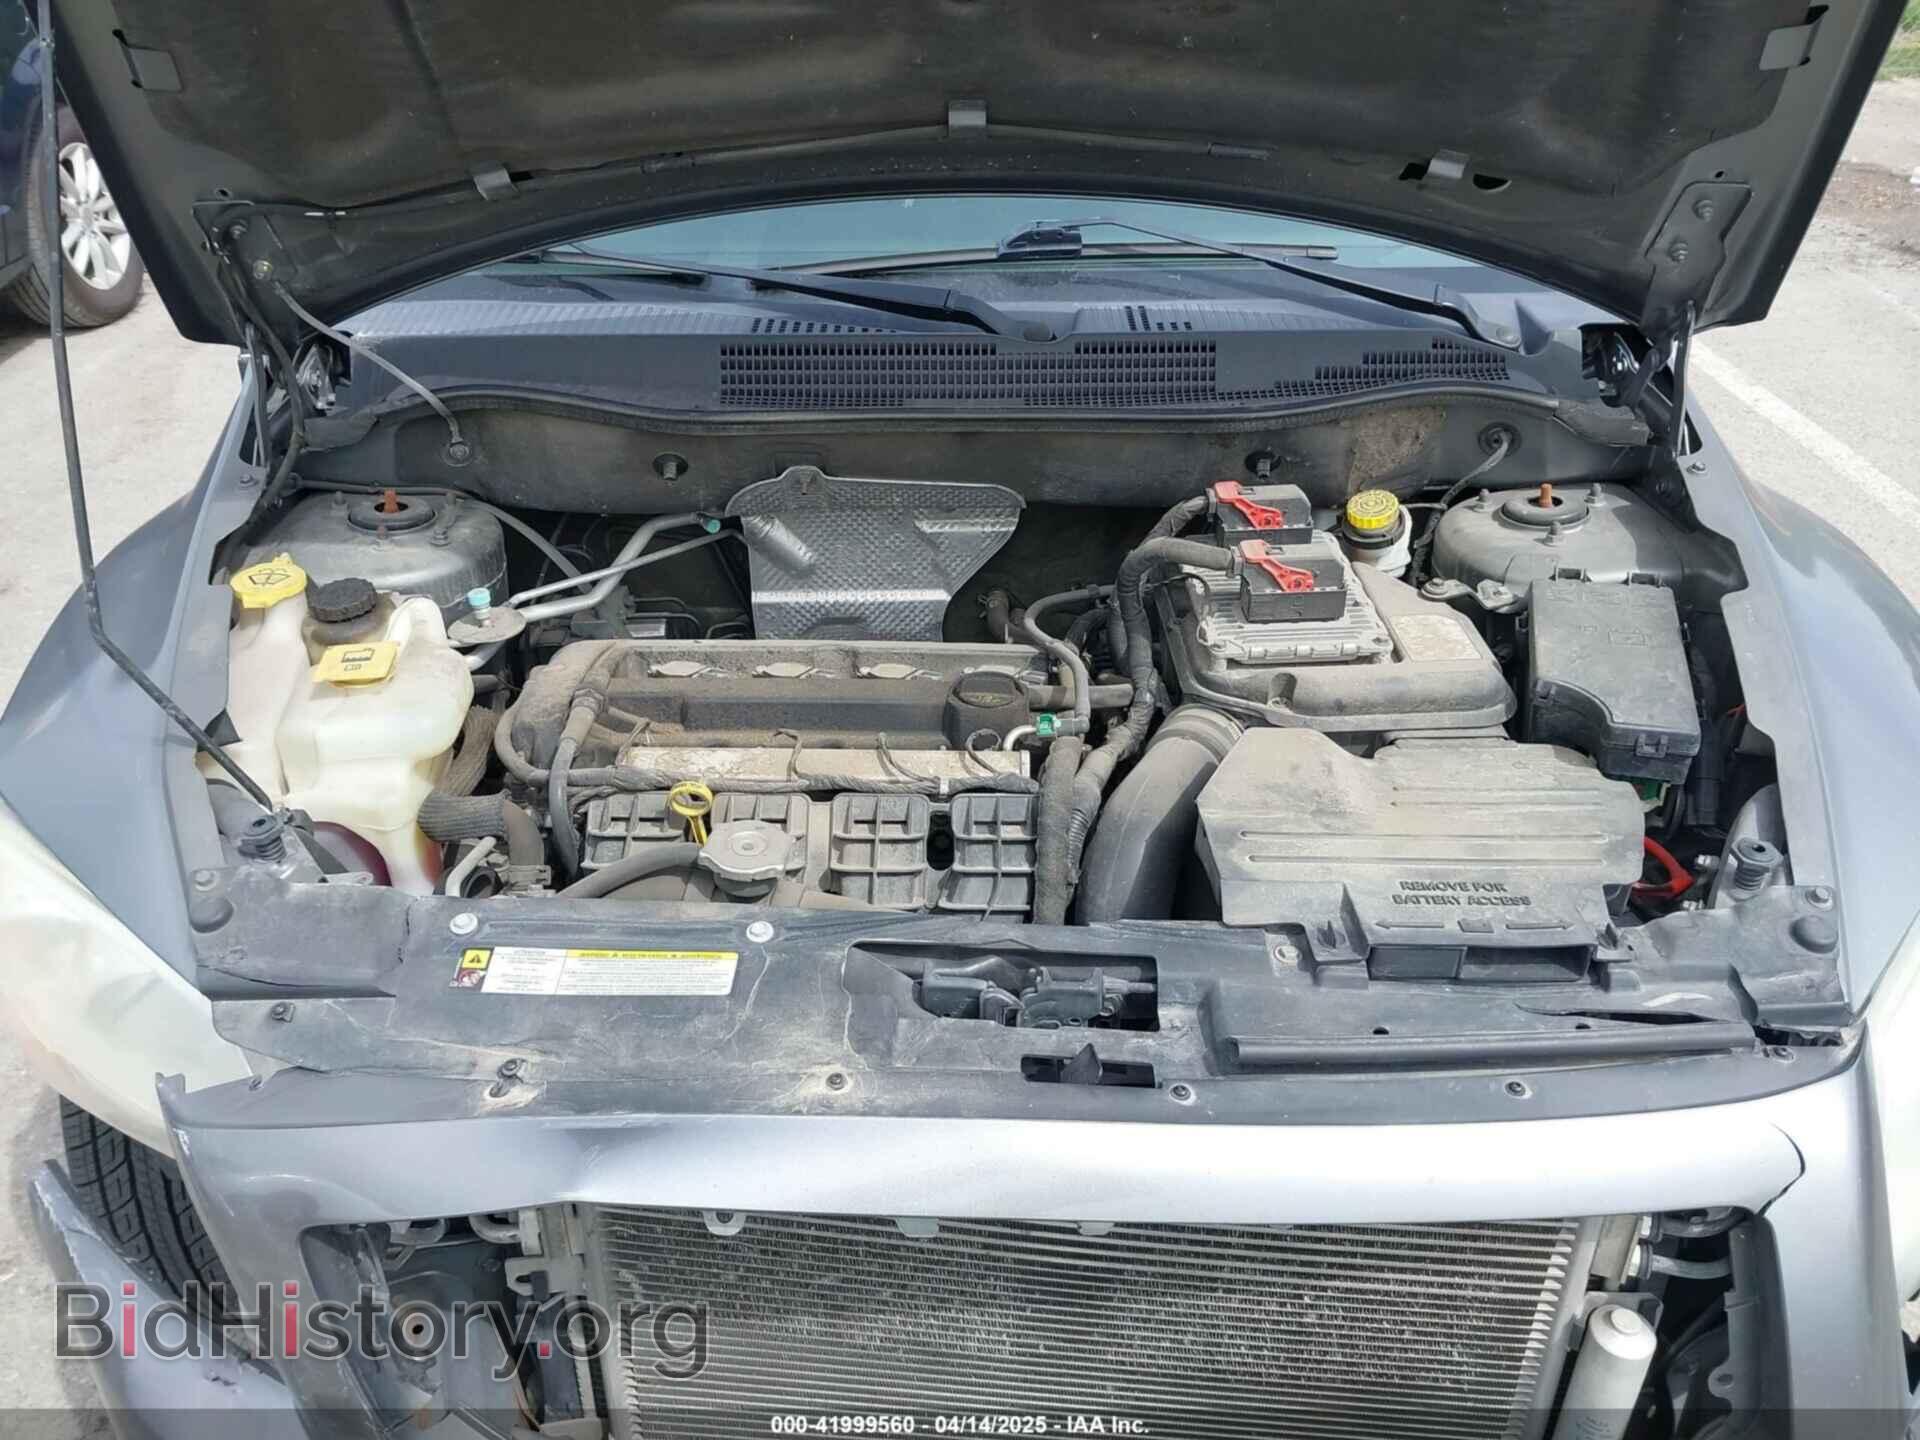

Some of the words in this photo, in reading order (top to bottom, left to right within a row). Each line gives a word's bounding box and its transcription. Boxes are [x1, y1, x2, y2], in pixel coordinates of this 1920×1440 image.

[1400, 881, 1470, 892] REMOVE
[1471, 882, 1507, 893] FOR
[1392, 894, 1462, 906] BATTERY
[1467, 895, 1531, 906] ACCESS
